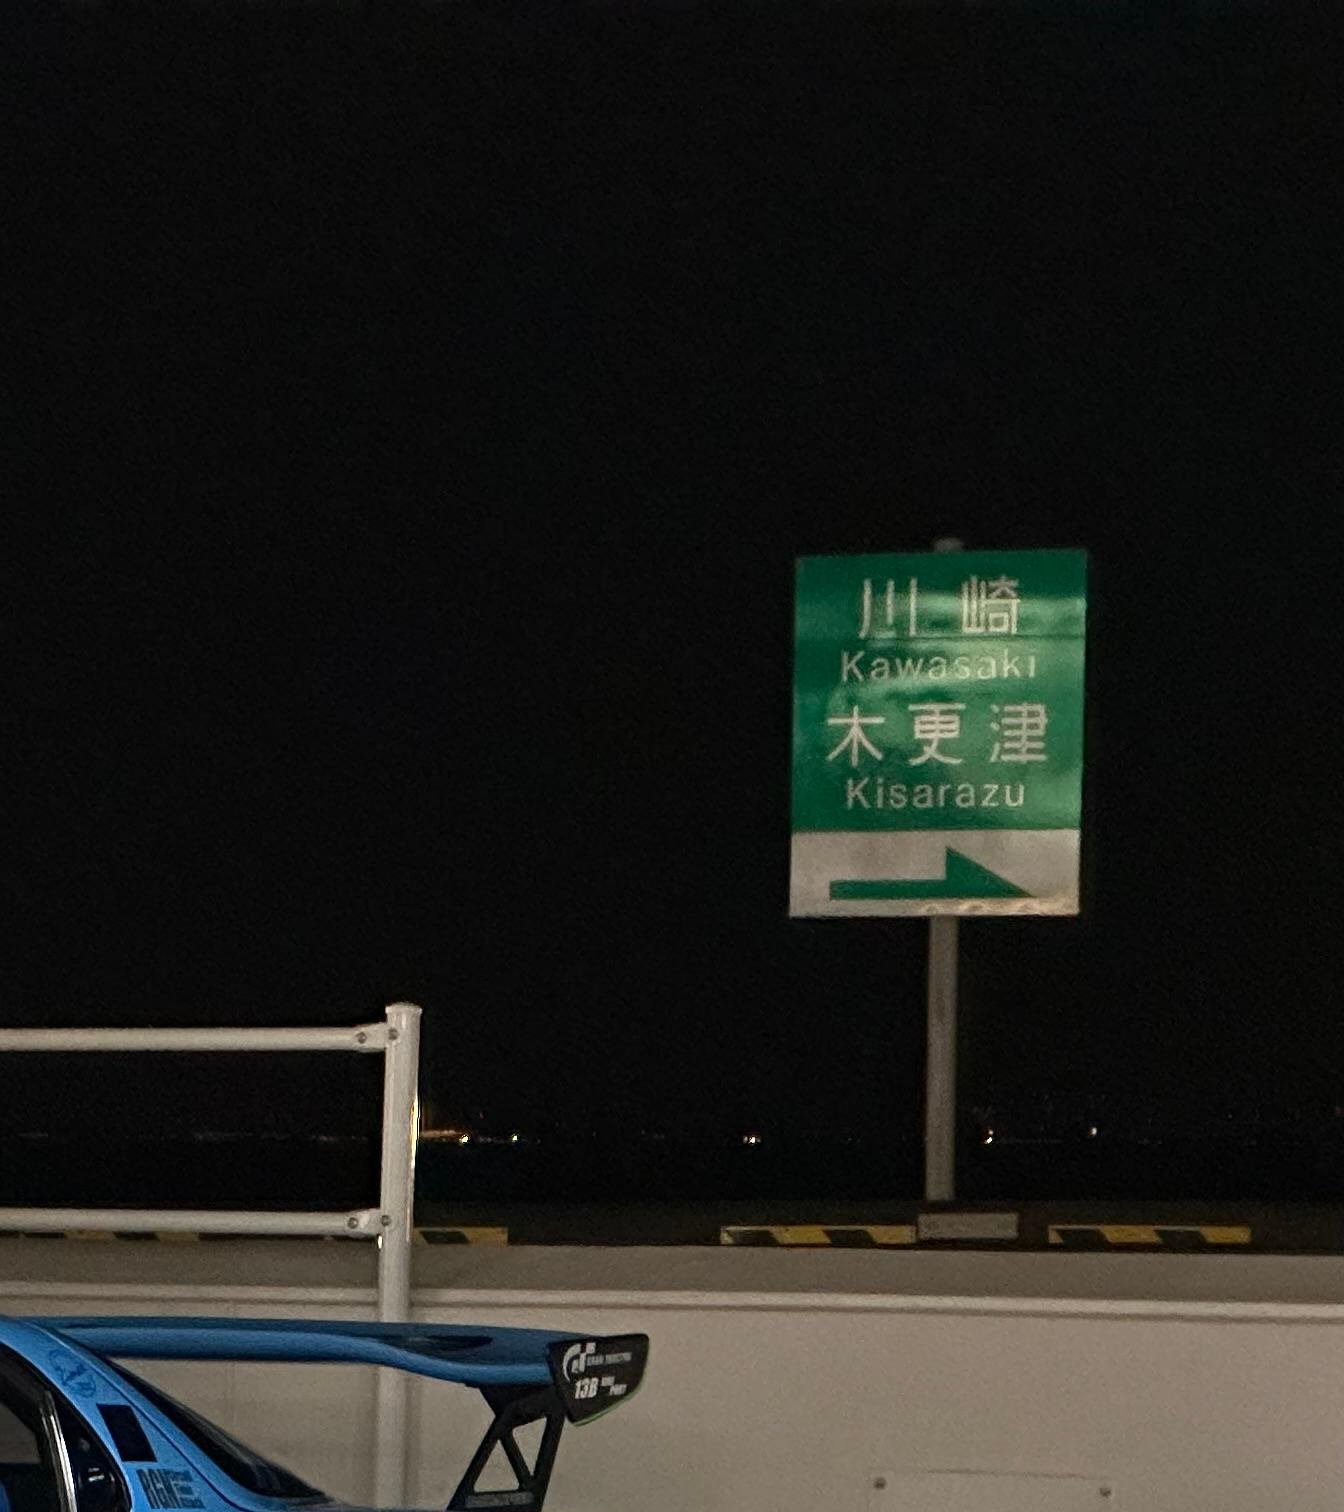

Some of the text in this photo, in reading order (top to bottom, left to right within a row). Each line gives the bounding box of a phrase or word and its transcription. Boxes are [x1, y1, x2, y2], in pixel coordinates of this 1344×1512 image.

[858, 573, 1021, 639] 川崎
[840, 648, 1037, 683] Kawasaki
[826, 702, 1049, 768] 木更津
[845, 776, 1026, 810] Kisarazu
